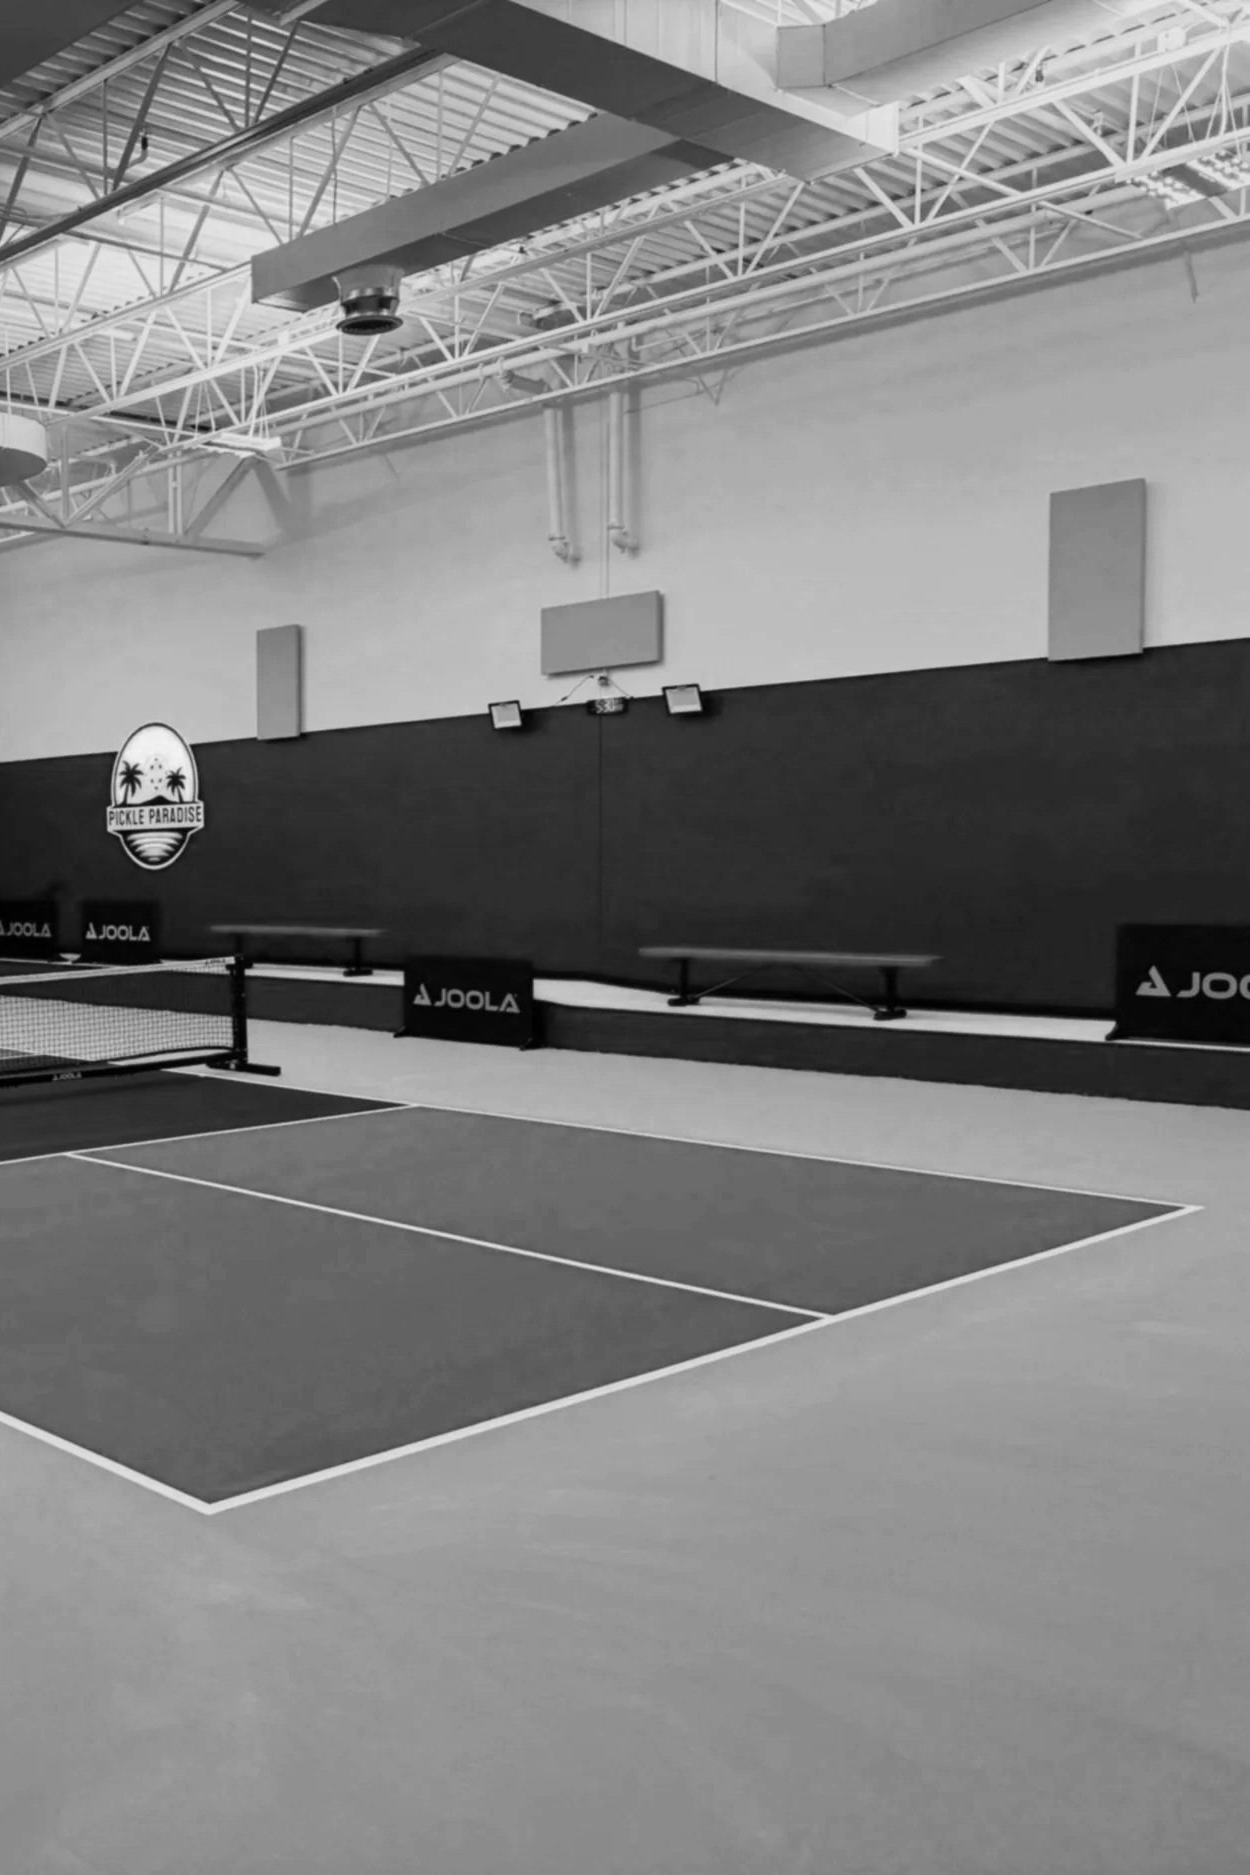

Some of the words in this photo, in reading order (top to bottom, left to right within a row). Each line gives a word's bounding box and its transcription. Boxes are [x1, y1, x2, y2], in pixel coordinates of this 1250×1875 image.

[108, 808, 145, 826] PICKLE
[148, 805, 202, 825] PARADISE
[6, 922, 52, 938] JOOLA
[99, 924, 151, 942] JOOLA
[434, 988, 521, 1014] JOOLA
